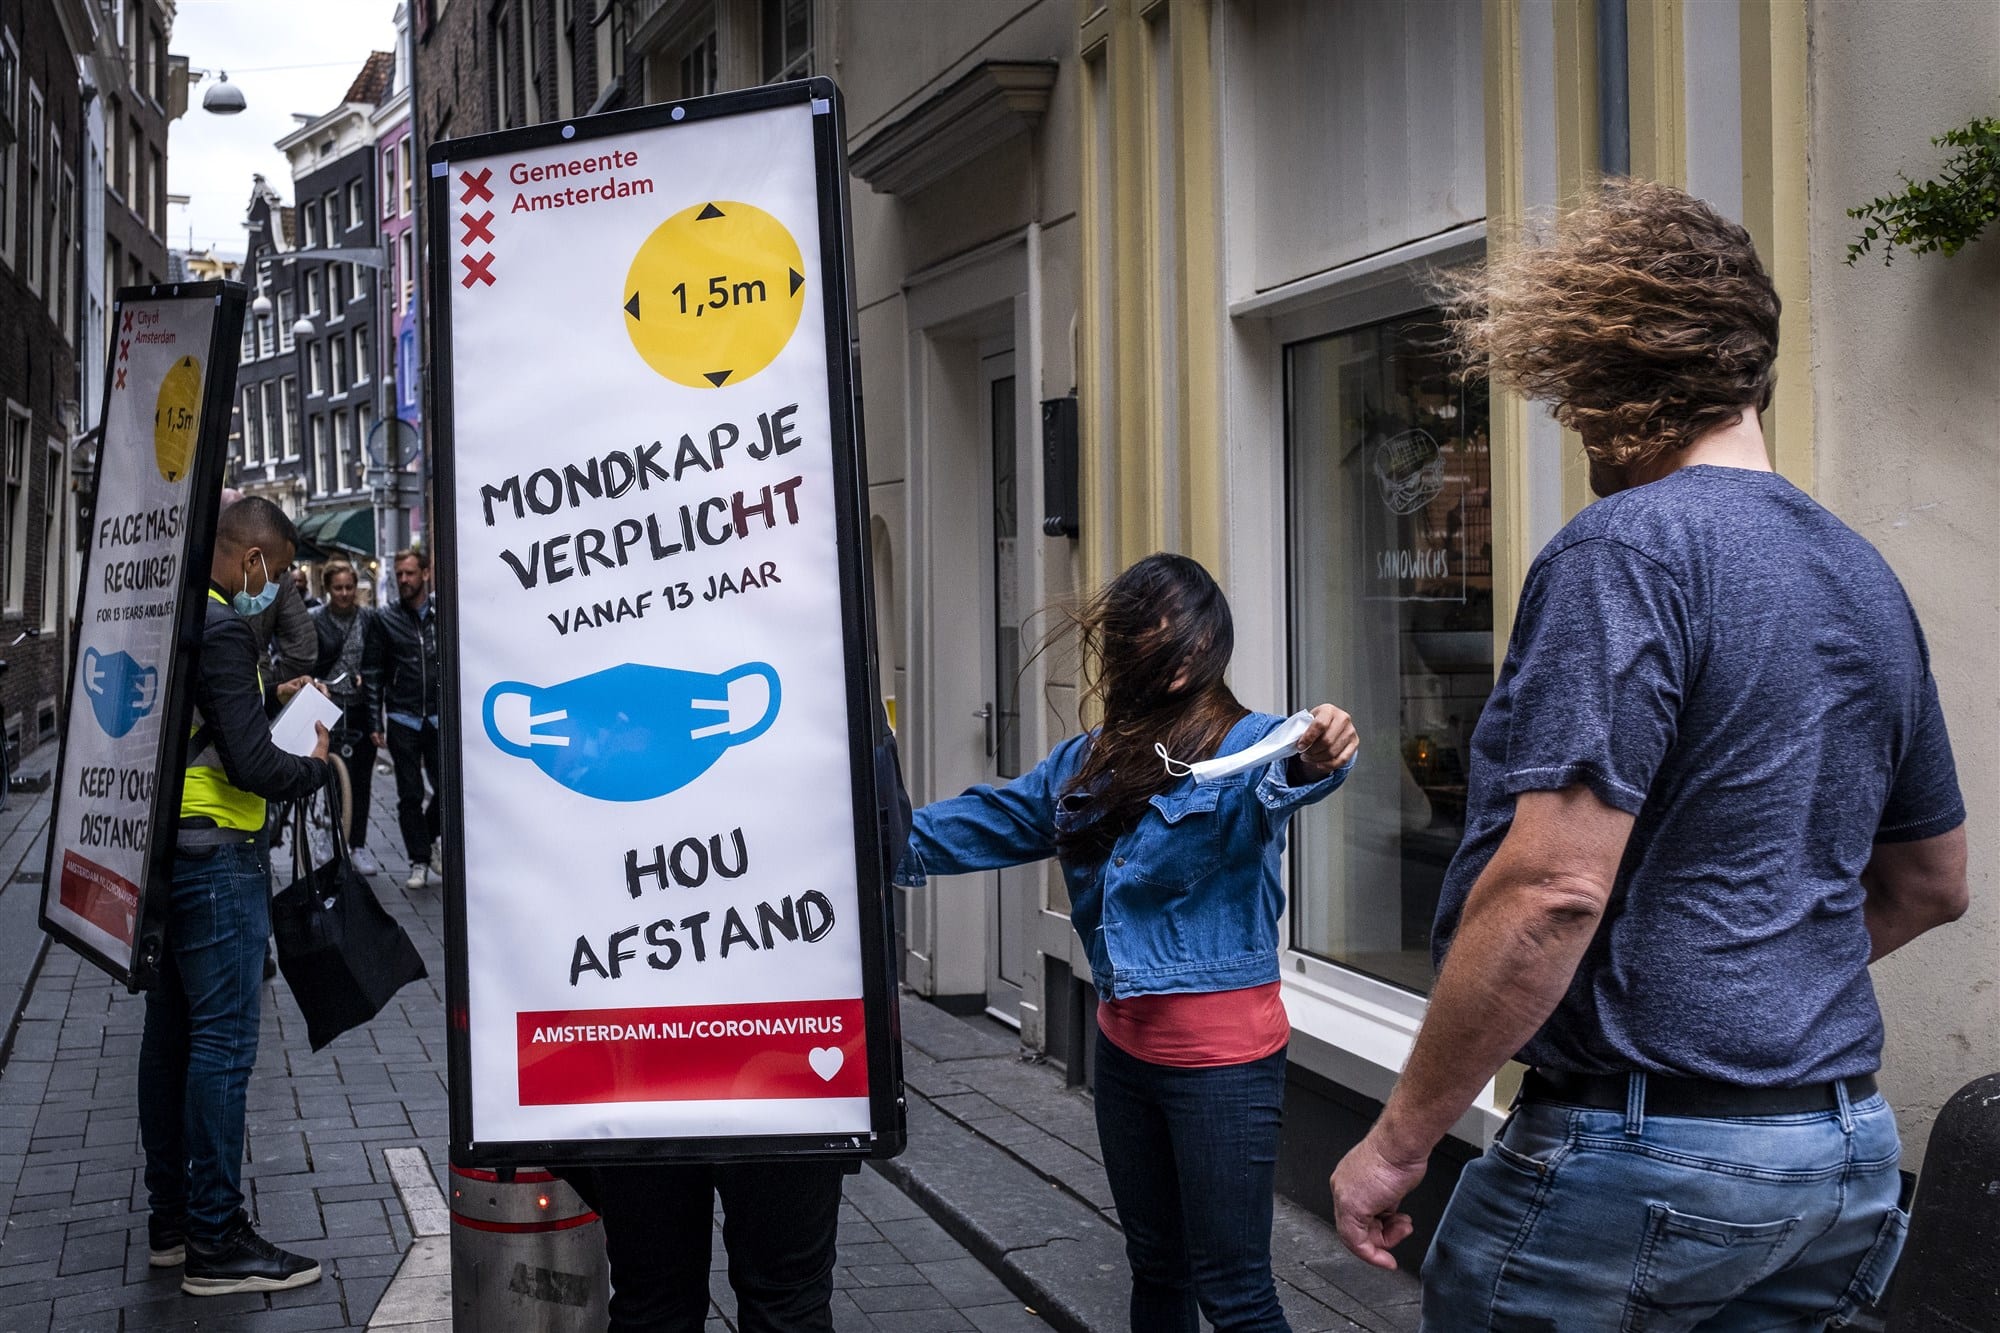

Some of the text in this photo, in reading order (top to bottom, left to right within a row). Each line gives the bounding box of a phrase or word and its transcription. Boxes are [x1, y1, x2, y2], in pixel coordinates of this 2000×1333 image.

[509, 150, 638, 185] Gemeente
[511, 177, 654, 214] Amsterdam
[671, 276, 767, 317] 1,5m
[135, 329, 176, 345] Amsterdam
[137, 308, 160, 328] City of
[167, 406, 194, 433] 1,5m
[479, 402, 803, 527] MONDKAPJE
[99, 503, 186, 549] FACE MASK
[499, 475, 803, 589] VERPLICHT
[104, 553, 176, 594] REQUIRED
[96, 607, 111, 623] FOR
[113, 607, 121, 621] 13
[122, 604, 143, 620] YEARS
[144, 603, 157, 618] AND
[547, 561, 782, 636] VANAF 13 JAAR
[79, 766, 154, 802] KEEP YOUR
[79, 813, 147, 852] DISTANCE
[624, 827, 749, 900] HOU
[569, 889, 835, 987] AFSTAND
[531, 1015, 843, 1044] AMSTERDAM.NL/CORONAVIRUS
